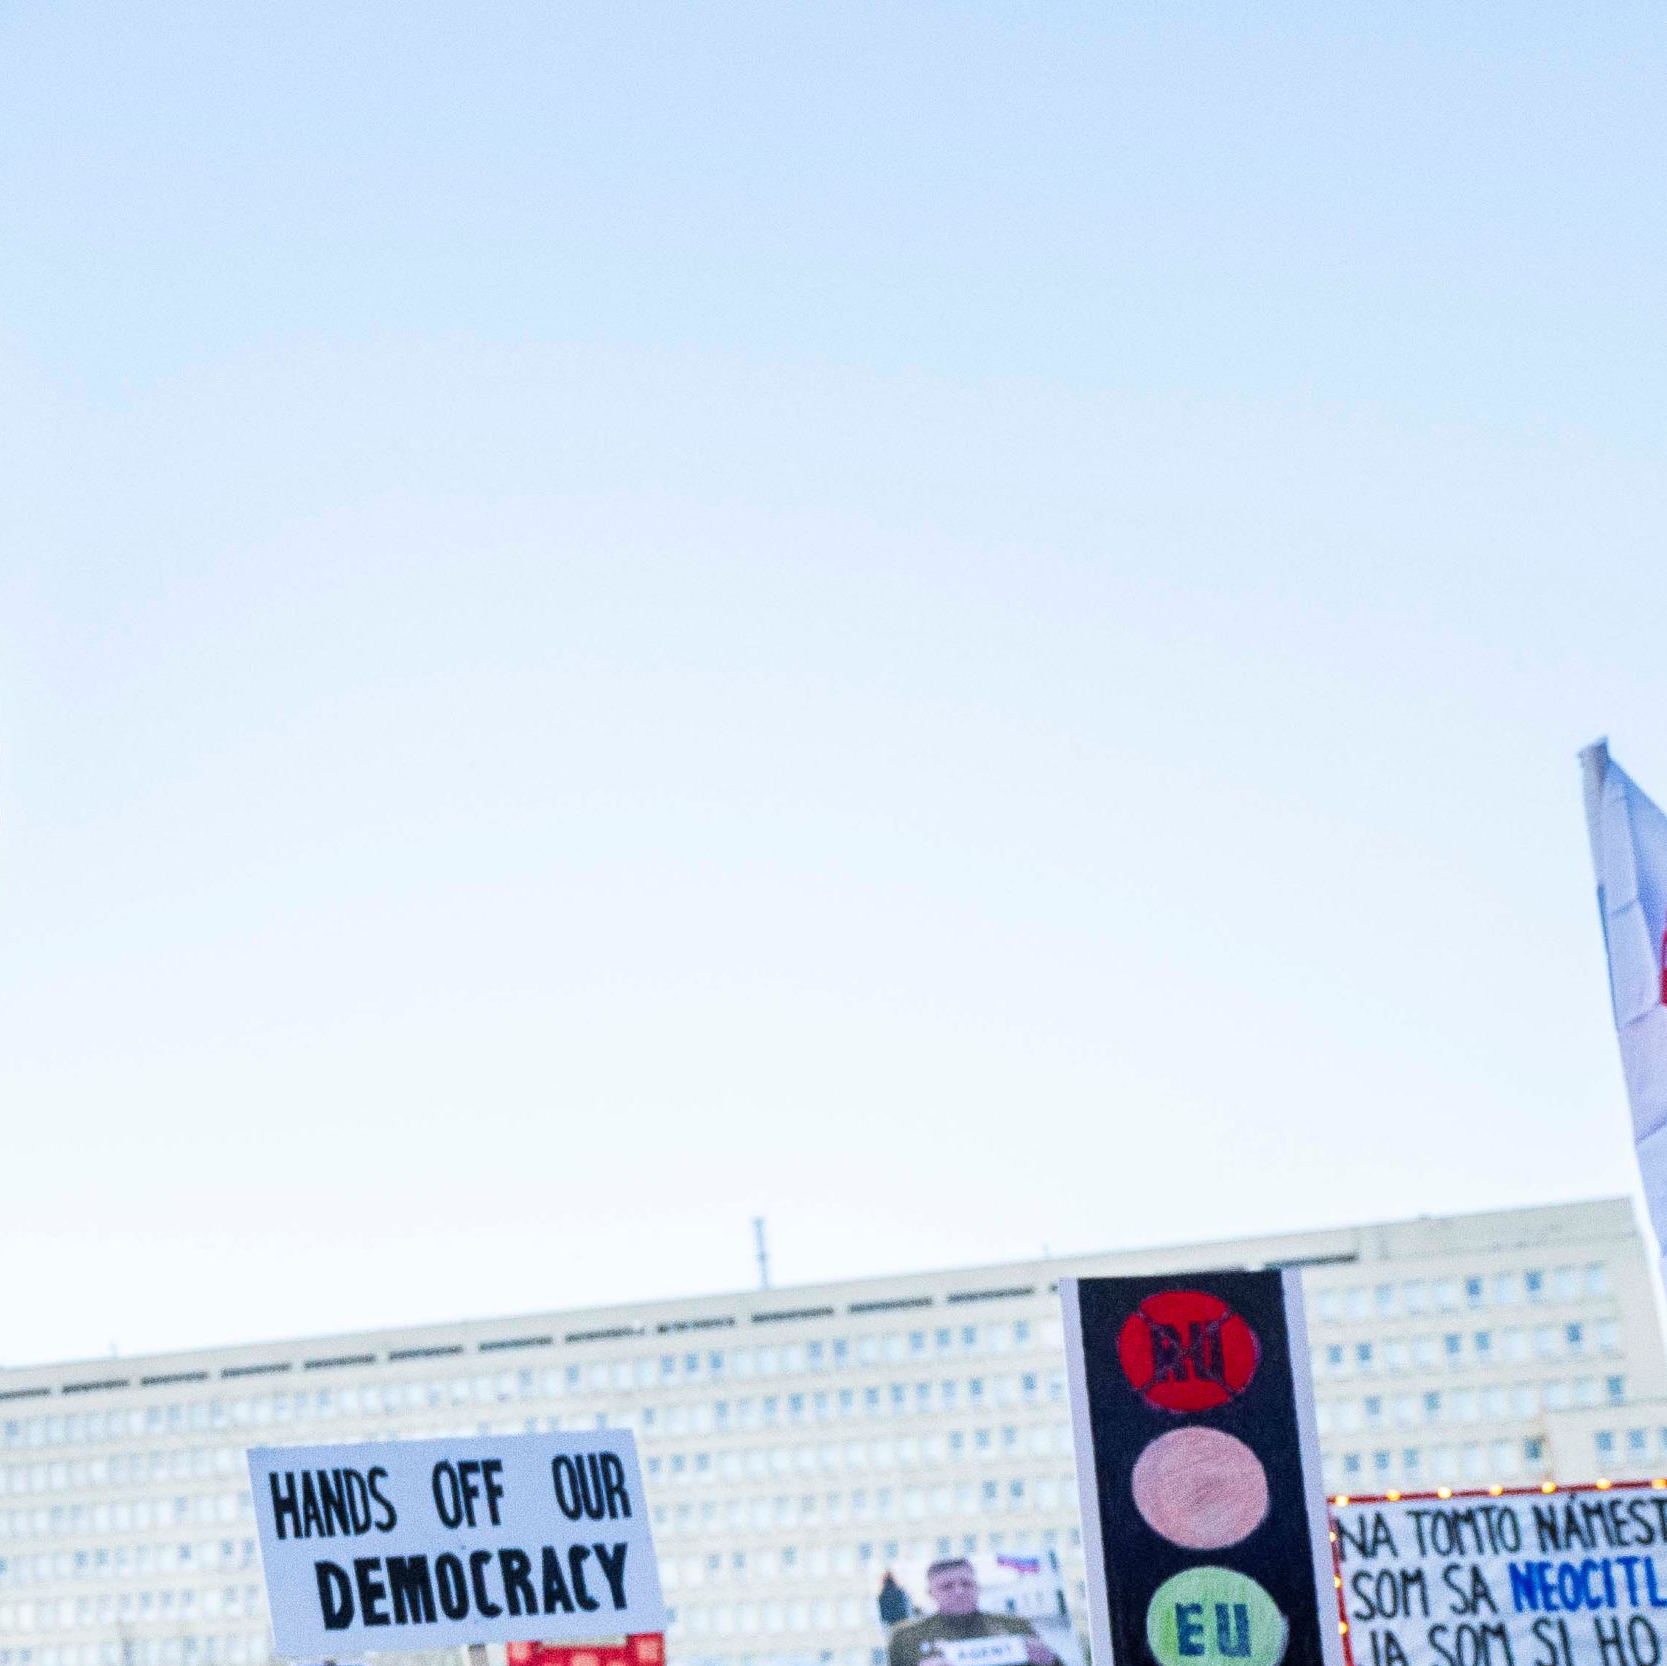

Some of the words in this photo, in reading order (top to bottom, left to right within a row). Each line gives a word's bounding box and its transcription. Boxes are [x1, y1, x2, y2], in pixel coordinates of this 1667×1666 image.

[268, 1465, 398, 1540] HANDS
[431, 1458, 503, 1529] OFF
[550, 1451, 632, 1522] OUR
[1336, 1511, 1398, 1561] NA
[1407, 1505, 1521, 1558] TOMTO
[313, 1542, 630, 1631] DEMOCRACY
[1351, 1567, 1429, 1621] SOM
[1441, 1561, 1499, 1615] SA
[1508, 1555, 1667, 1613] NEOCITL
[1175, 1601, 1251, 1659] EU
